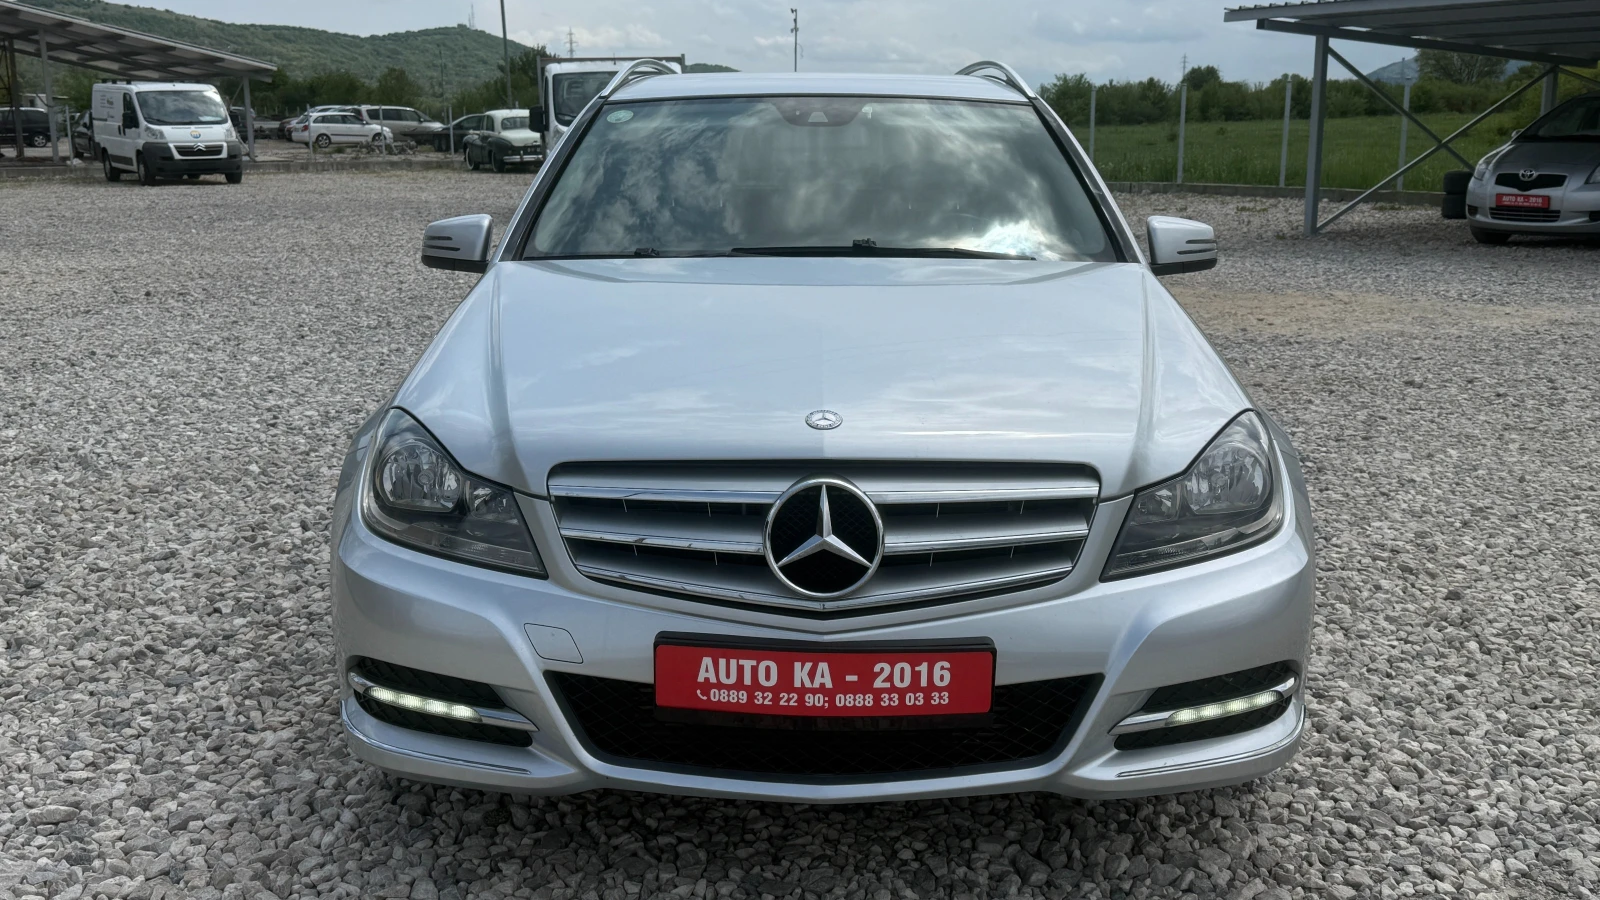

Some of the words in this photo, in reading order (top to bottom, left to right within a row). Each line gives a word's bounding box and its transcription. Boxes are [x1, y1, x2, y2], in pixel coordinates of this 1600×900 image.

[697, 657, 777, 686] AUTO
[794, 662, 833, 688] KA
[873, 661, 950, 688] 2016
[710, 689, 747, 703] 0889
[754, 692, 772, 704] 32
[780, 693, 797, 705] 22
[805, 694, 828, 709] 90;
[836, 694, 873, 706] 0888
[881, 693, 898, 706] 33
[906, 693, 924, 705] 03
[931, 692, 948, 704] 33
